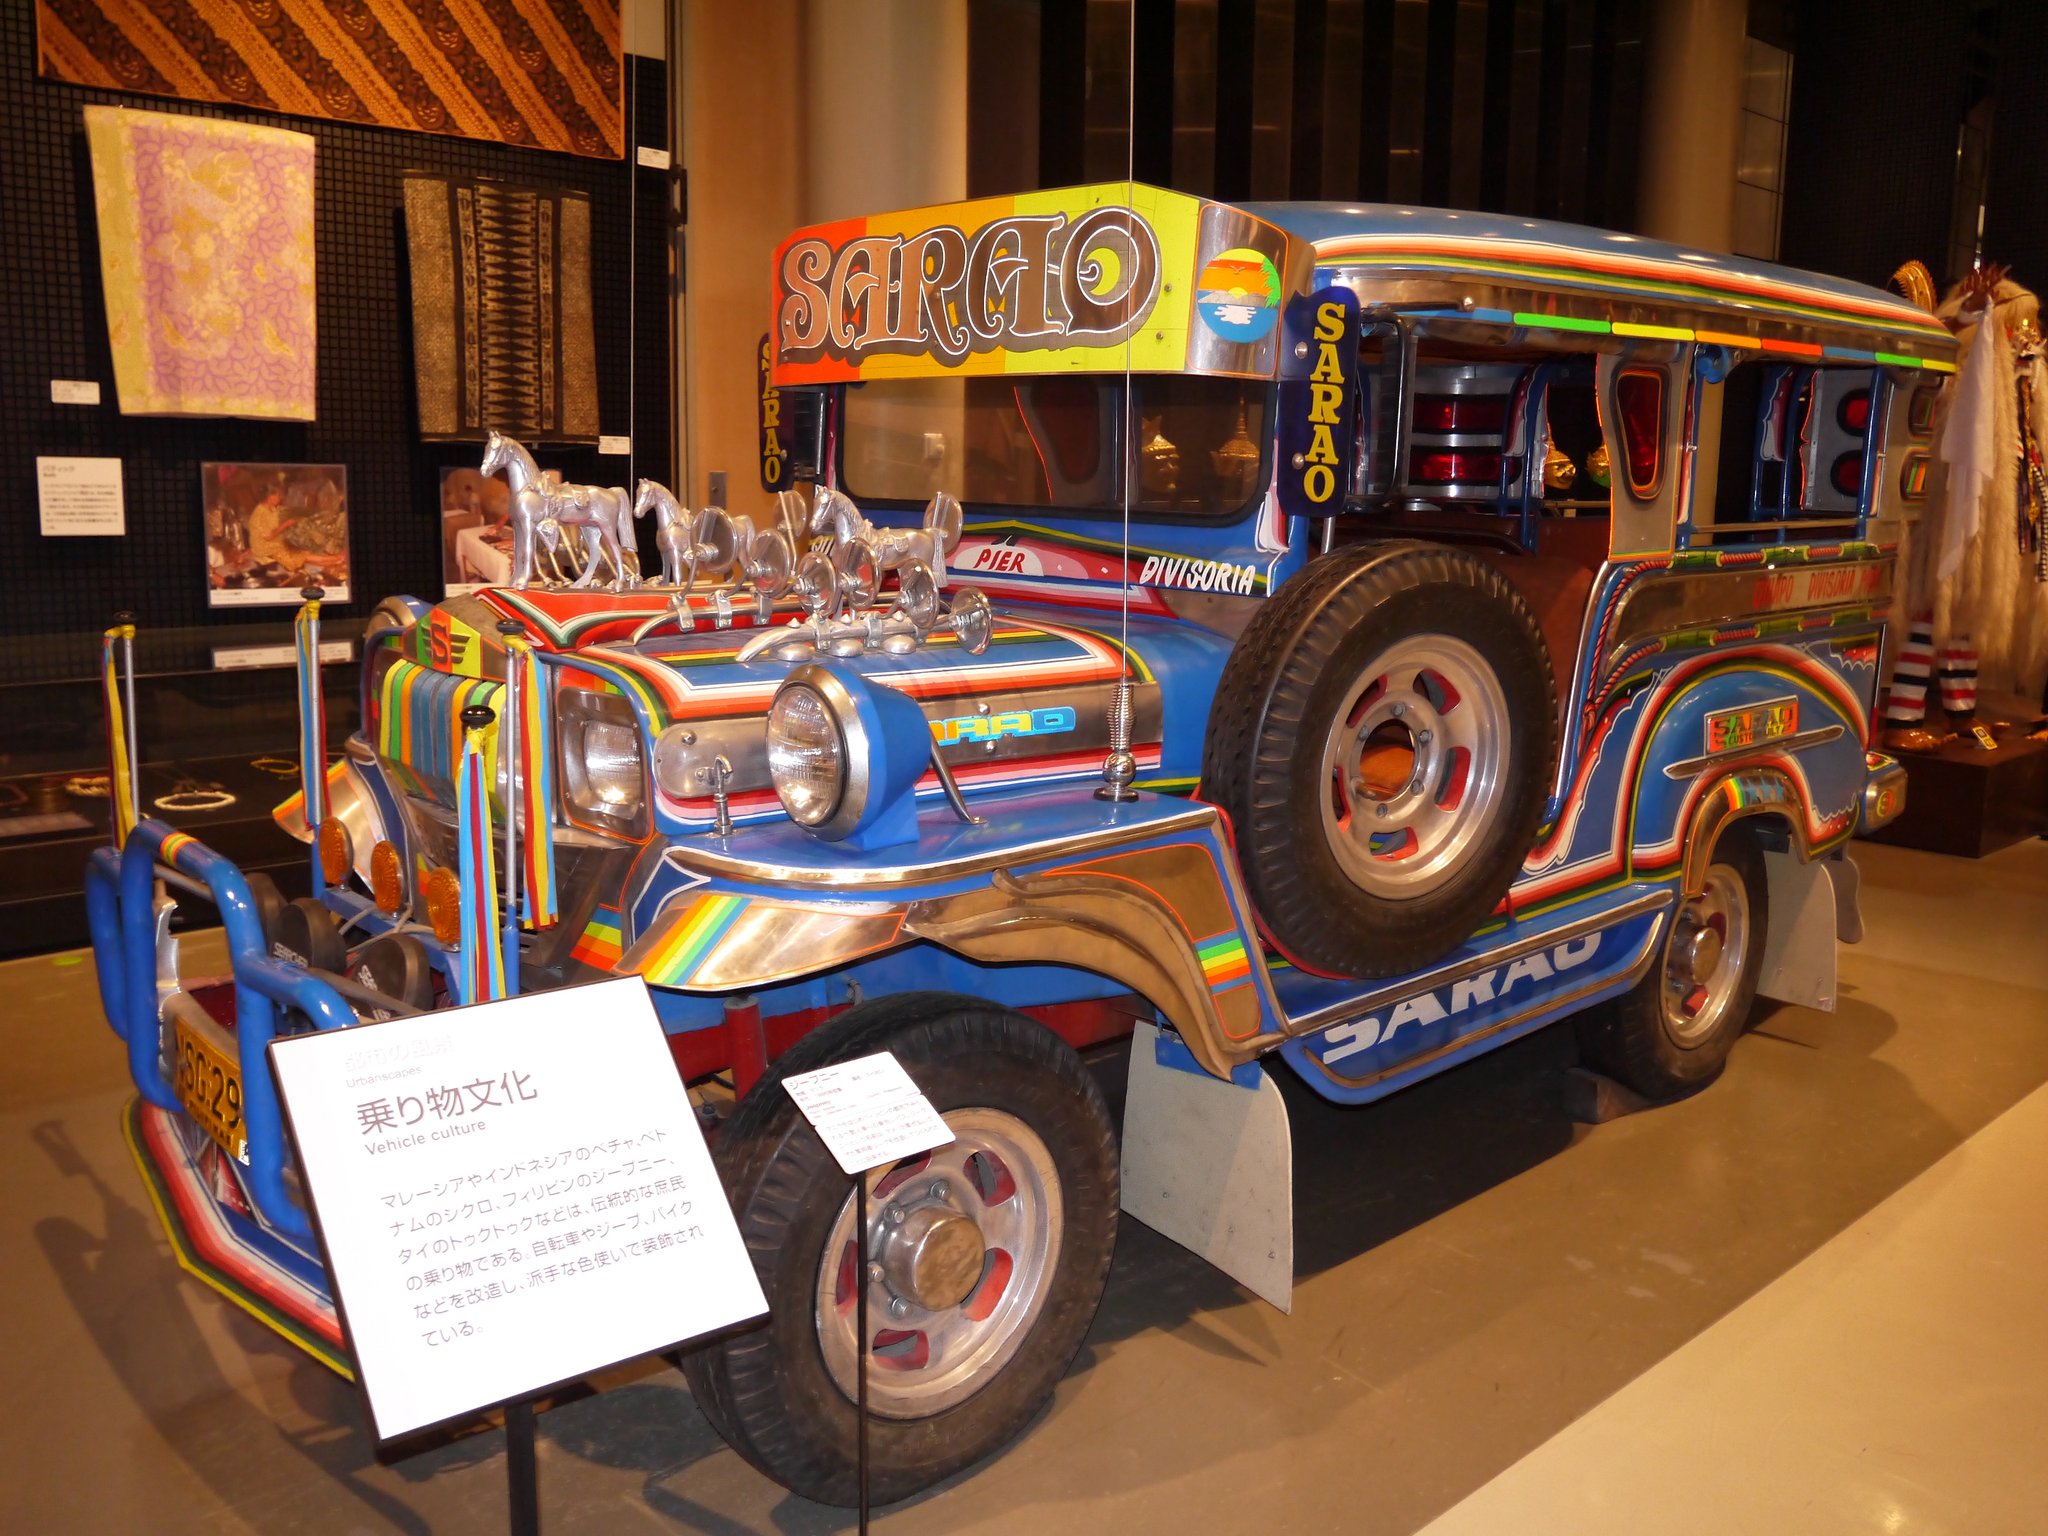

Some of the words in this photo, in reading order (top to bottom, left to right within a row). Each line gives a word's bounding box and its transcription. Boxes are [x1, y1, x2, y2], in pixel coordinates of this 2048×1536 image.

[779, 206, 1161, 356] SARAO
[1303, 302, 1346, 503] SARAO
[973, 548, 1026, 574] PIER
[1139, 556, 1256, 596] DIVISORIA
[928, 706, 1076, 746] RAO
[1323, 931, 1602, 1065] SARAO
[345, 1066, 423, 1089] Urbanscapes
[356, 1070, 538, 1135] 乗り物文化
[364, 1133, 427, 1156] Vehicle
[431, 1120, 487, 1142] culture
